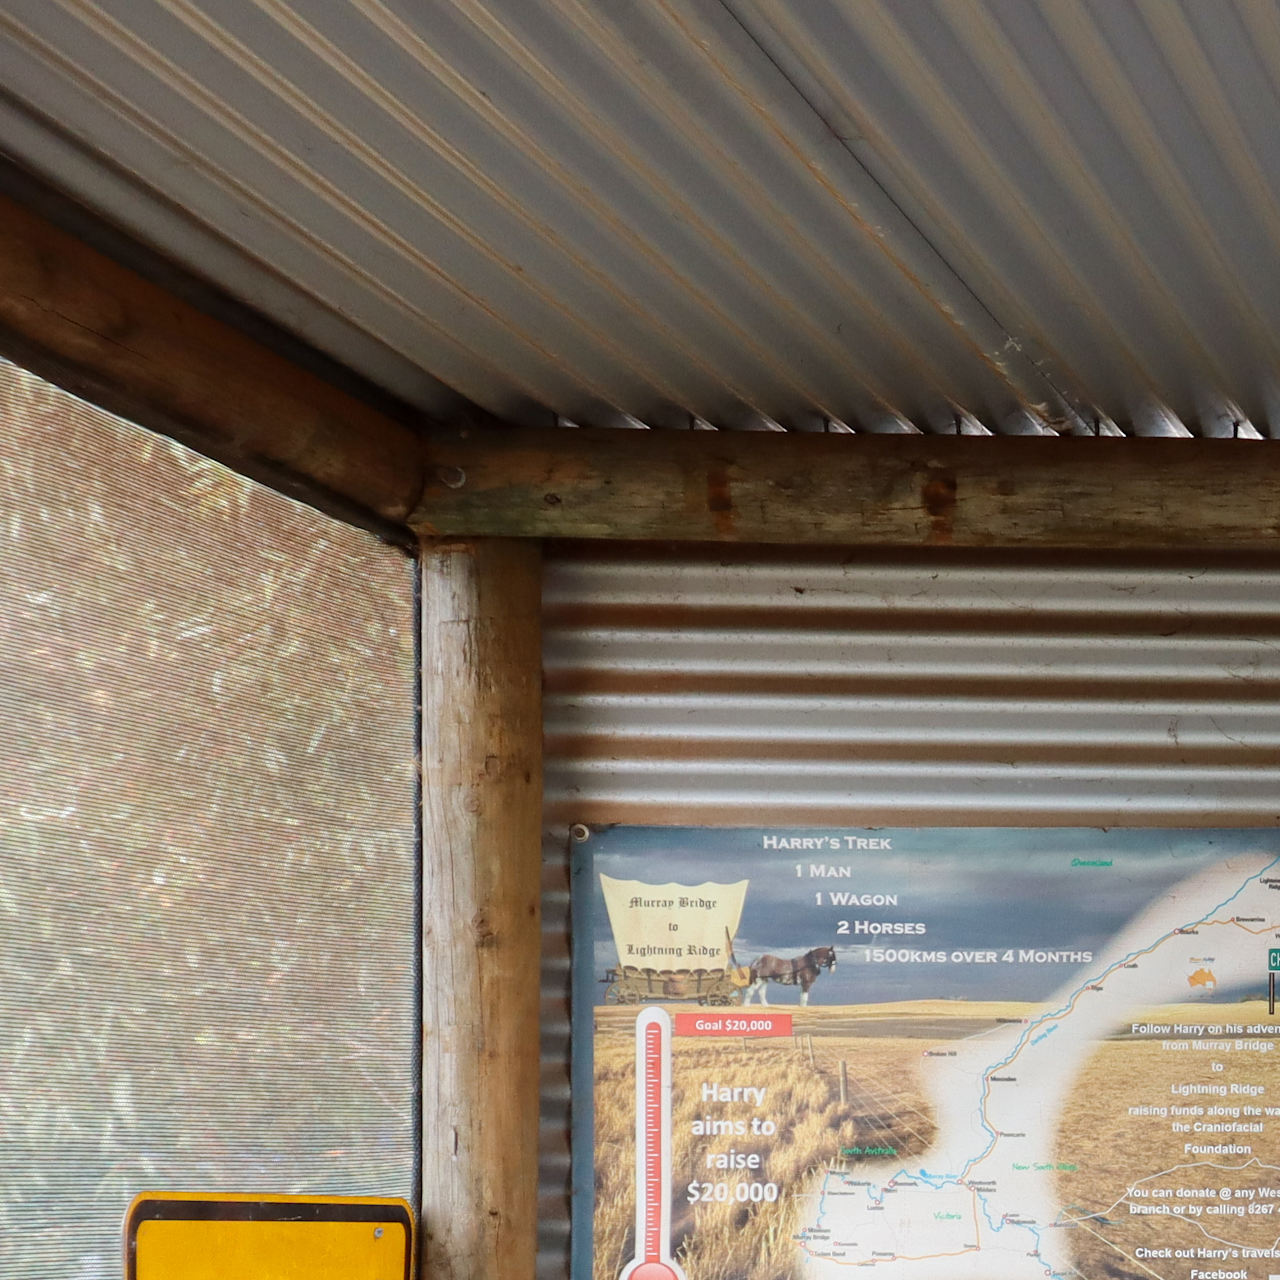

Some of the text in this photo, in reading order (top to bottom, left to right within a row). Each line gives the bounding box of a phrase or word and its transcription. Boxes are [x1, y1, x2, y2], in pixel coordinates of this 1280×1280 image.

[762, 836, 892, 850] HARRY'S TREK
[795, 864, 851, 878] 1 MAN
[628, 897, 718, 910] Murray Bridge
[815, 892, 898, 906] 1 WAGON
[668, 922, 679, 932] to
[837, 921, 926, 934] 2 HORSES
[626, 944, 721, 959] Lightning Ridge
[951, 950, 997, 963] OVER
[1001, 950, 1014, 963] 4
[1018, 950, 1092, 963] MONTHS
[696, 1020, 772, 1032] Goal $20,000
[1132, 1024, 1172, 1034] Follow
[1174, 1024, 1205, 1036] Harry
[1208, 1026, 1222, 1034] on
[1226, 1024, 1244, 1034] his
[1162, 1040, 1275, 1053] from Murray Bridge
[1211, 1062, 1224, 1072] to
[701, 1082, 766, 1107] Harry
[1171, 1084, 1265, 1096] Lightning Ridge
[1128, 1106, 1168, 1118] raising
[1170, 1106, 1204, 1116] funds
[1207, 1106, 1240, 1118] along
[1243, 1106, 1262, 1116] the
[691, 1116, 776, 1136] aims to
[1172, 1122, 1264, 1133] the Craniofacial
[1184, 1144, 1252, 1154] Foundation
[706, 1149, 760, 1169] raise
[686, 1179, 778, 1205] $20,000
[1127, 1187, 1149, 1198] You
[1152, 1189, 1173, 1198] can
[1176, 1188, 1216, 1198] donate
[1219, 1188, 1232, 1200] @
[1234, 1190, 1256, 1200] any
[1130, 1204, 1170, 1215] branch
[1172, 1206, 1184, 1215] or
[1188, 1204, 1202, 1216] by
[1206, 1204, 1245, 1216] calling
[1248, 1204, 1274, 1215] 8267
[1135, 1248, 1172, 1258] Check
[1174, 1249, 1195, 1258] out
[1197, 1248, 1238, 1260] Harry's
[1242, 1248, 1280, 1258] travels
[1190, 1270, 1248, 1280] Facebook
